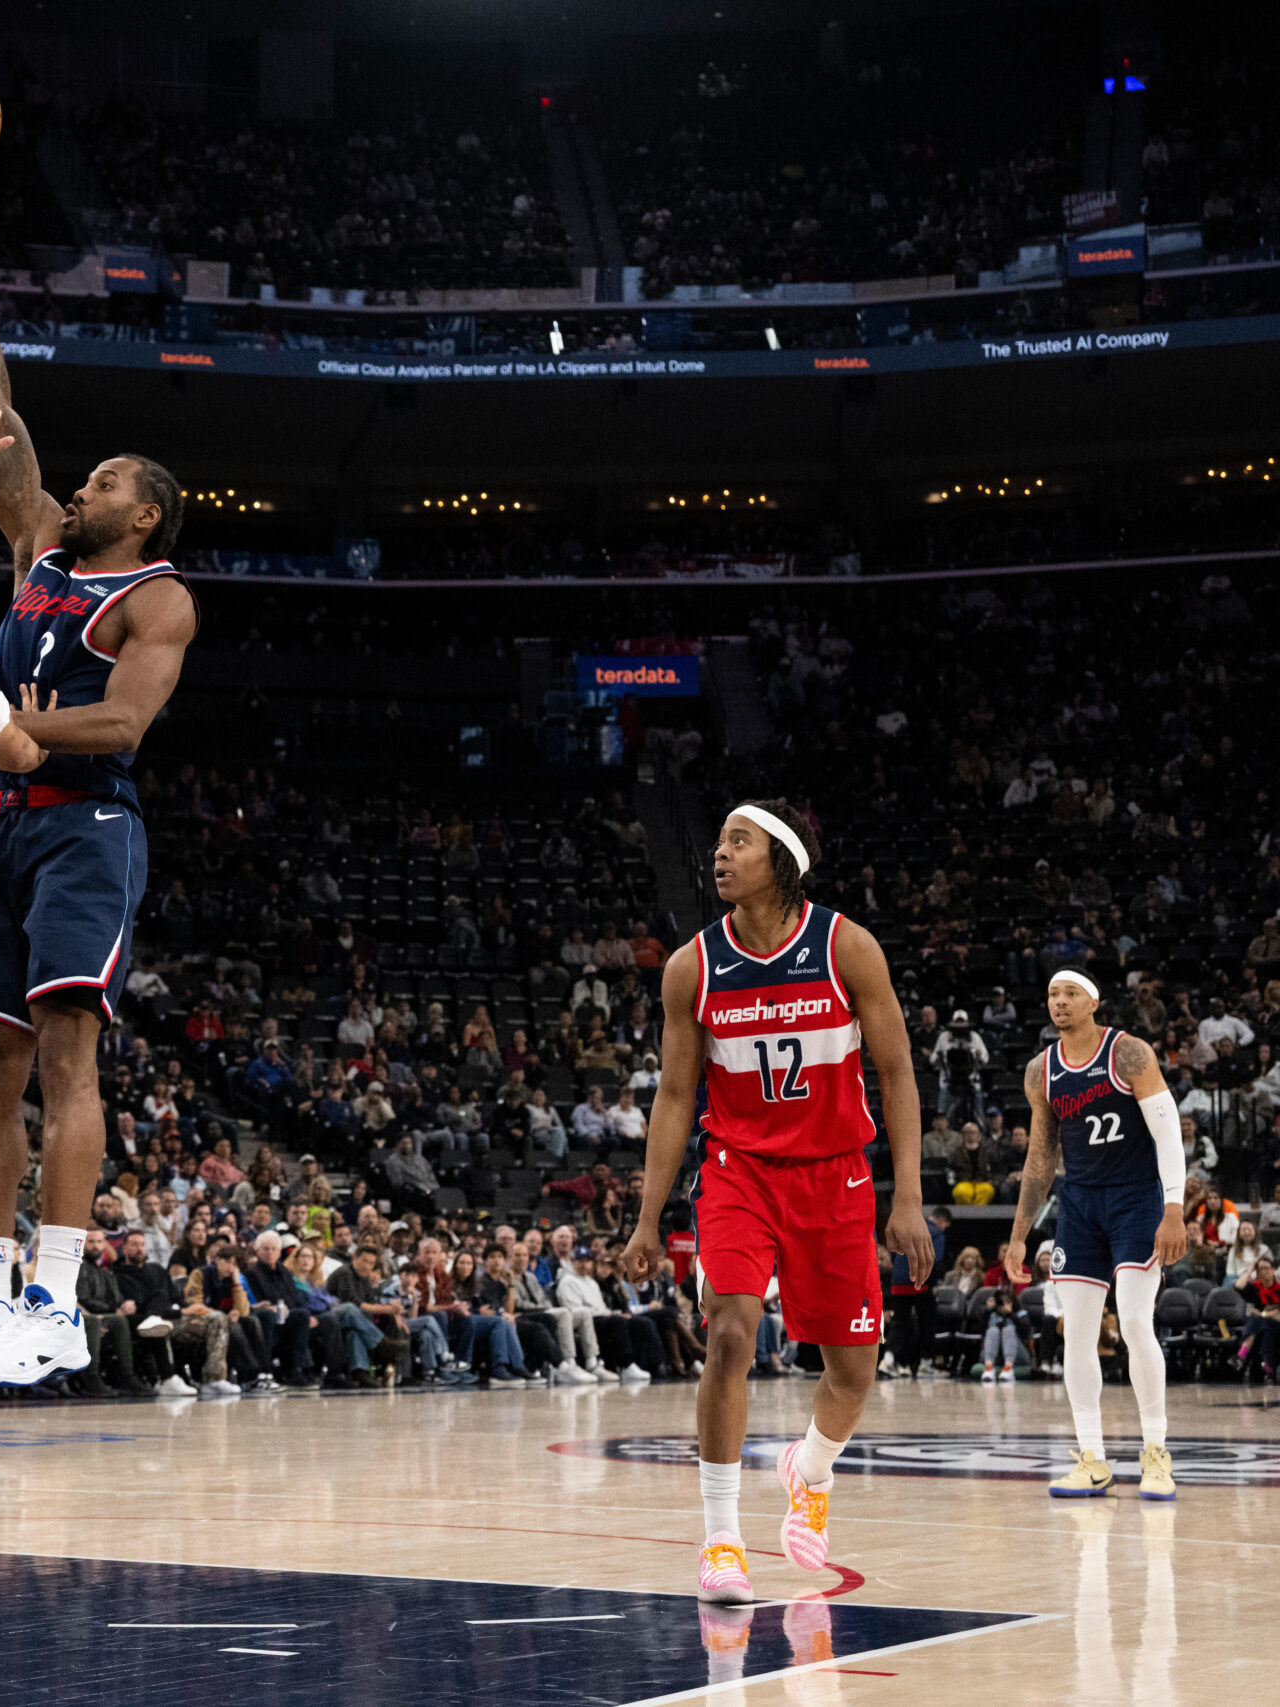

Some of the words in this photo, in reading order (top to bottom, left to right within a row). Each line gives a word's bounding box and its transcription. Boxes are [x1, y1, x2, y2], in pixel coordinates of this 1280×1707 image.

[0, 342, 56, 361] ompany
[981, 343, 1011, 358] The
[1015, 337, 1071, 356] Trusted
[1076, 335, 1092, 350] AI
[1096, 331, 1169, 349] Company
[318, 360, 359, 375] Official
[361, 363, 395, 377] Cloud
[397, 364, 452, 380] Analytics
[453, 363, 497, 377] Partner
[500, 362, 513, 376] of
[515, 362, 536, 376] the
[538, 362, 556, 375] LA
[557, 361, 608, 376] Clippers
[609, 361, 633, 374] and
[636, 360, 666, 373] Intuit
[669, 359, 705, 373] Dome
[787, 966, 820, 976] Robinhood
[711, 997, 831, 1026] washington
[754, 1037, 810, 1102] 12
[1052, 1080, 1114, 1121] Clippers
[1085, 1112, 1125, 1146] 22
